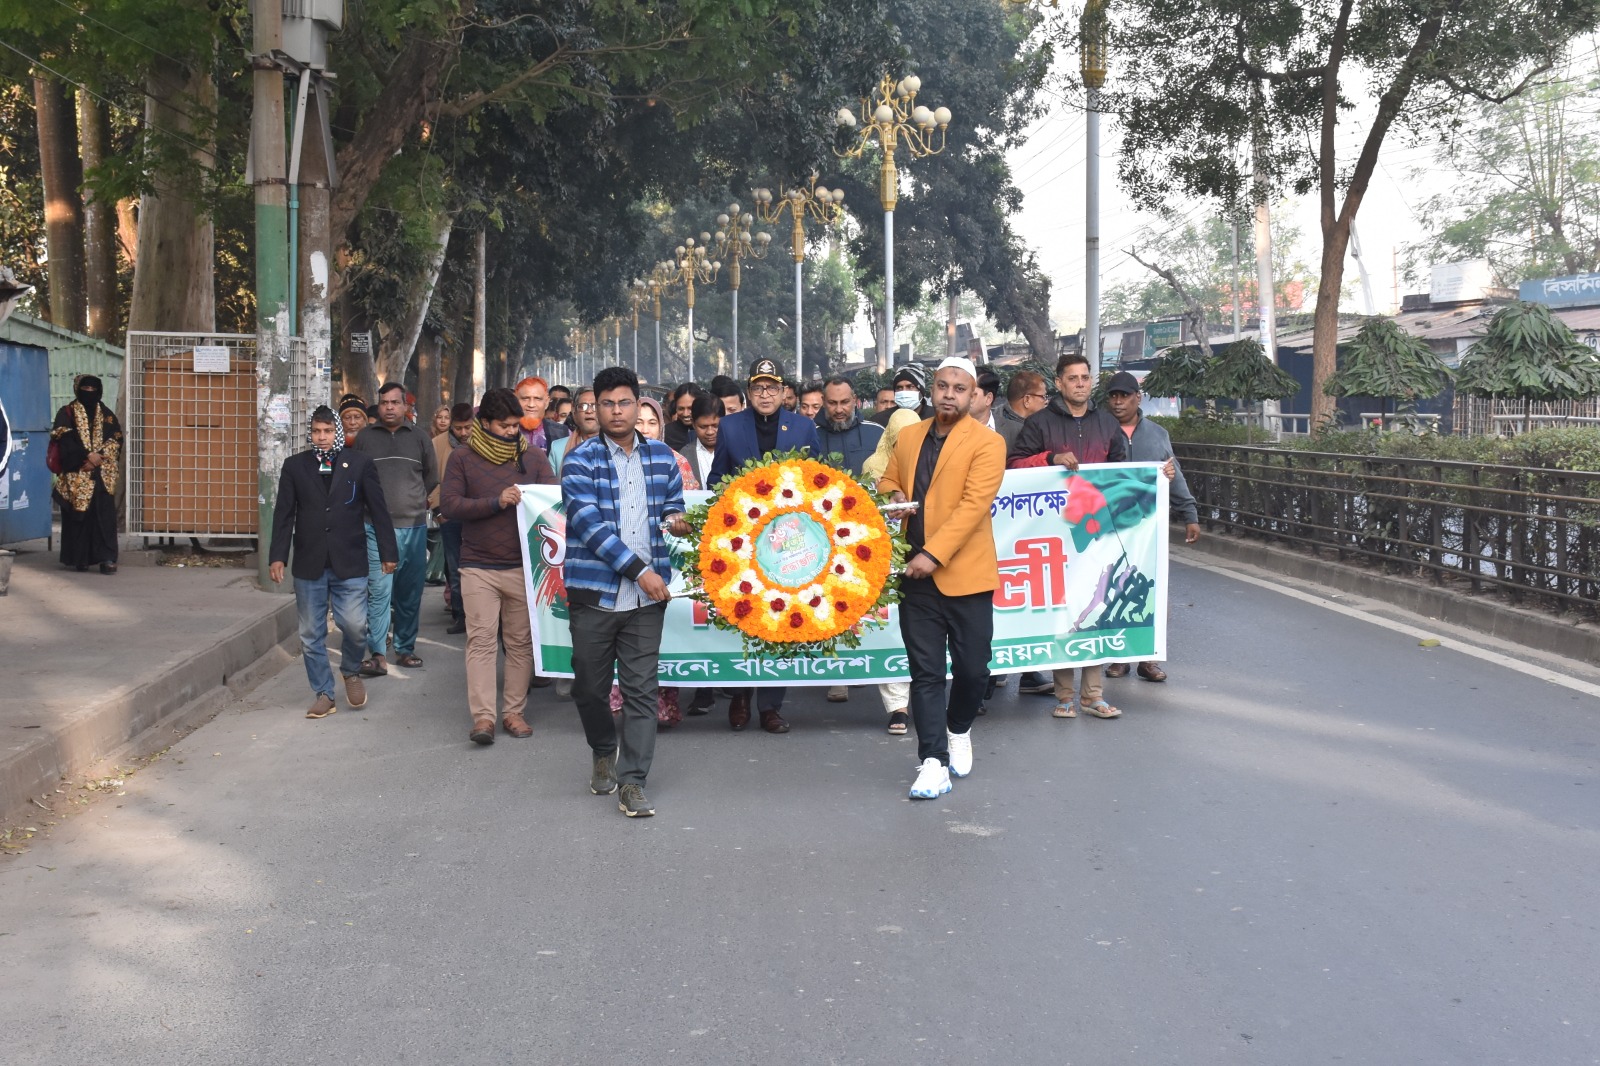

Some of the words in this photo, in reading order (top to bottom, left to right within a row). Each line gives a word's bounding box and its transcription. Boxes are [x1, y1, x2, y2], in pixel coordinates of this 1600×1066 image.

[538, 524, 566, 567] ১
[992, 537, 1067, 607] লী
[730, 654, 875, 677] বাংলাদেশ
[994, 640, 1054, 665] ন্নয়ন
[1064, 628, 1127, 657] বোর্ড
